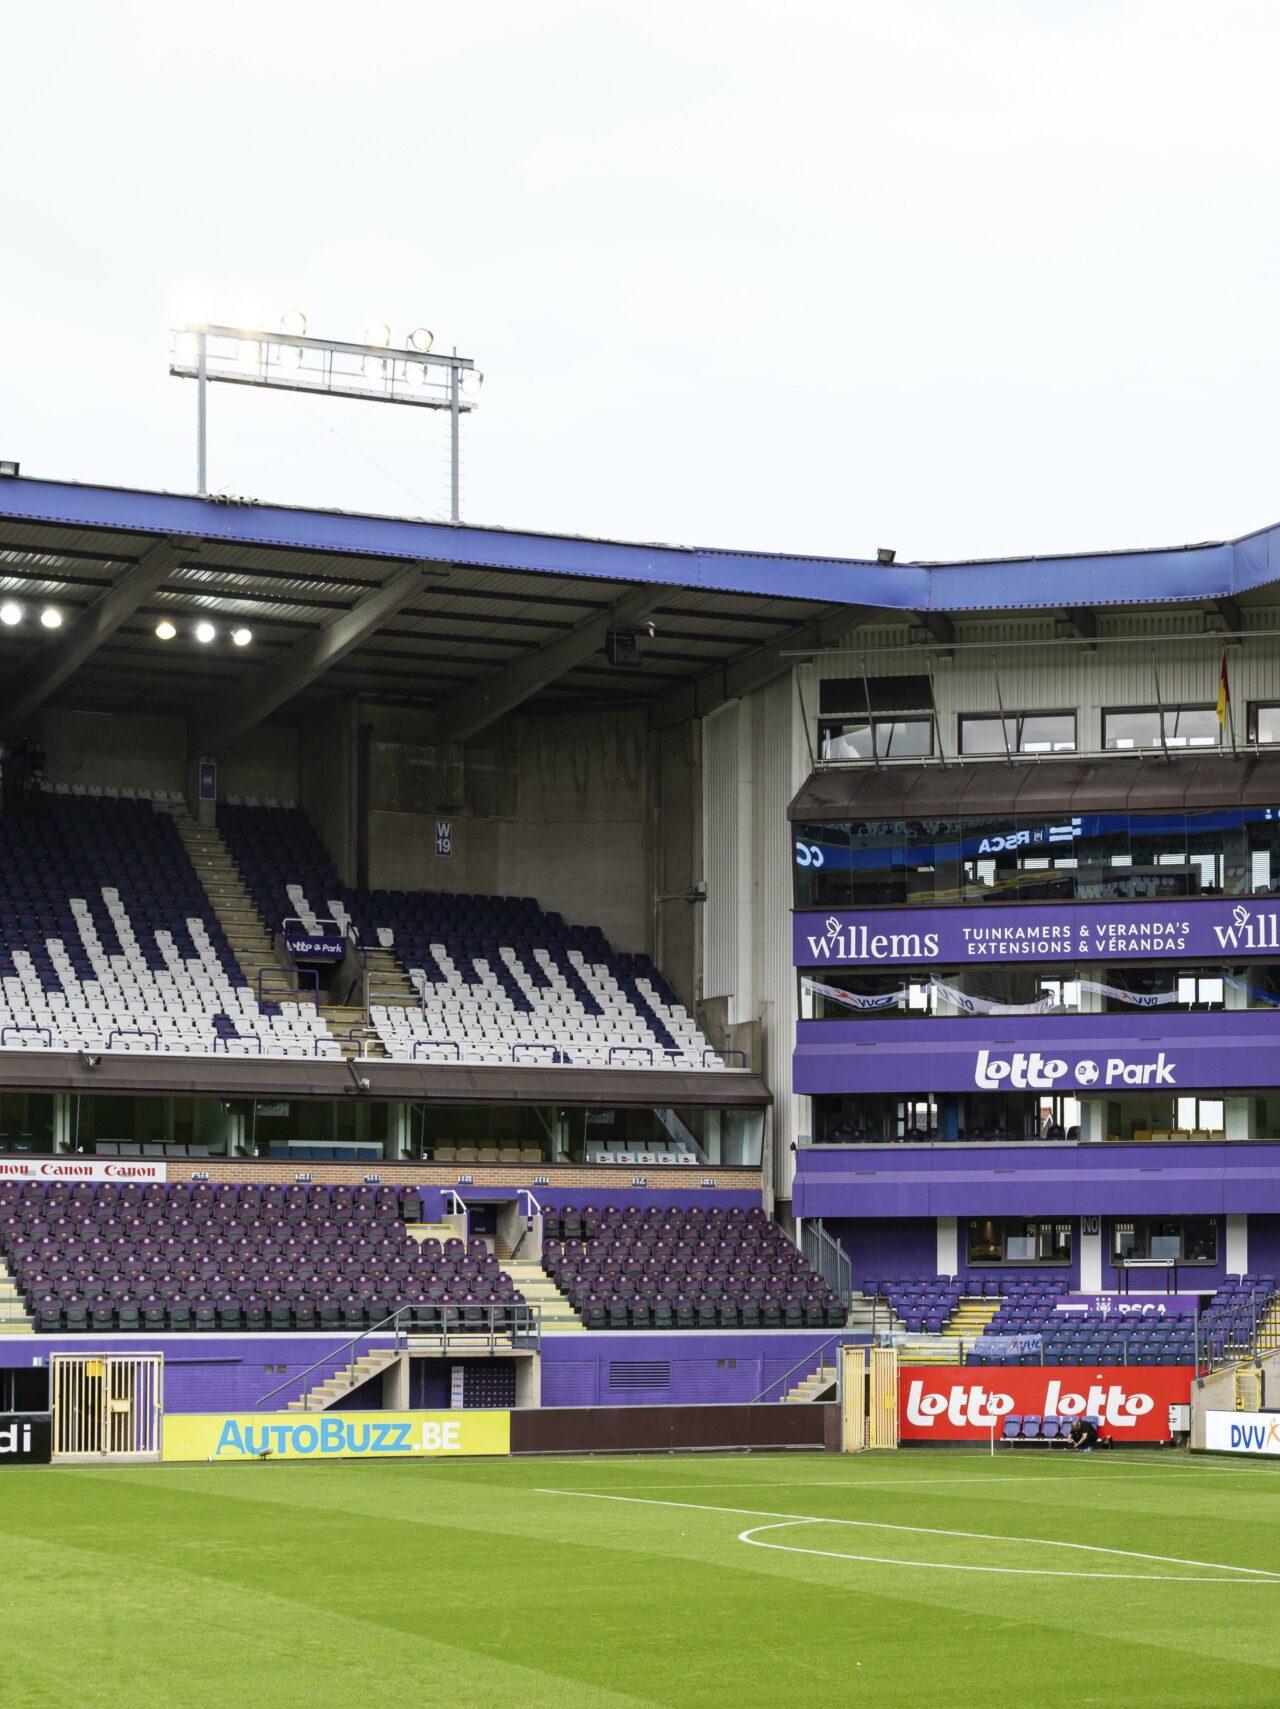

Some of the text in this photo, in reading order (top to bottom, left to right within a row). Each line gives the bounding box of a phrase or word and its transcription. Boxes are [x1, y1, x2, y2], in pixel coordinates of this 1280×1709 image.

[436, 823, 451, 838] W
[436, 838, 451, 853] 19
[807, 922, 939, 960] willems
[962, 921, 1190, 941] TUINKAMERS & VERANDA'S
[967, 937, 1186, 956] EXTENSIONS & VÉRANDAS
[974, 1049, 1177, 1090] lotto Park
[40, 1163, 93, 1176] Canon
[104, 1164, 156, 1177] Canon
[906, 1380, 1155, 1427] lotto lotto
[1230, 1423, 1266, 1451] DVV
